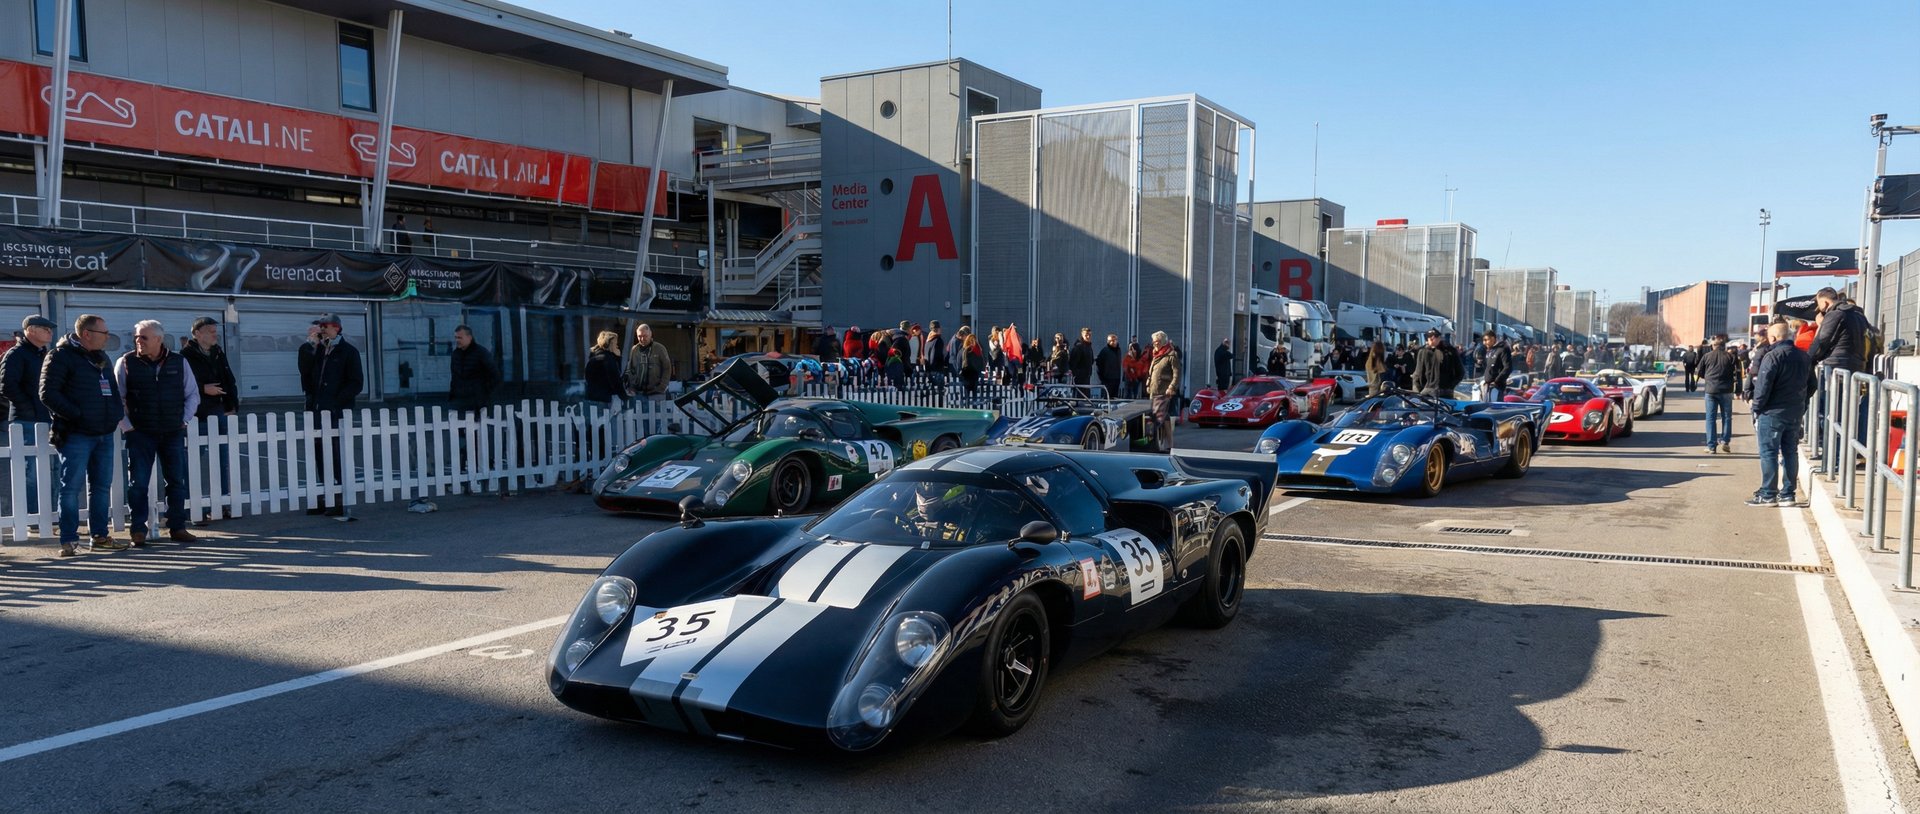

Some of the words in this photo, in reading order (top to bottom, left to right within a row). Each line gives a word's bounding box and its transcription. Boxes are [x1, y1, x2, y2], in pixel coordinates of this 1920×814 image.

[832, 182, 867, 196] Media
[832, 198, 869, 210] Center
[894, 174, 959, 262] A
[264, 263, 342, 283] terenacat
[1279, 258, 1313, 300] B
[870, 442, 889, 460] 42
[1120, 536, 1155, 577] 35
[645, 610, 717, 642] 35
